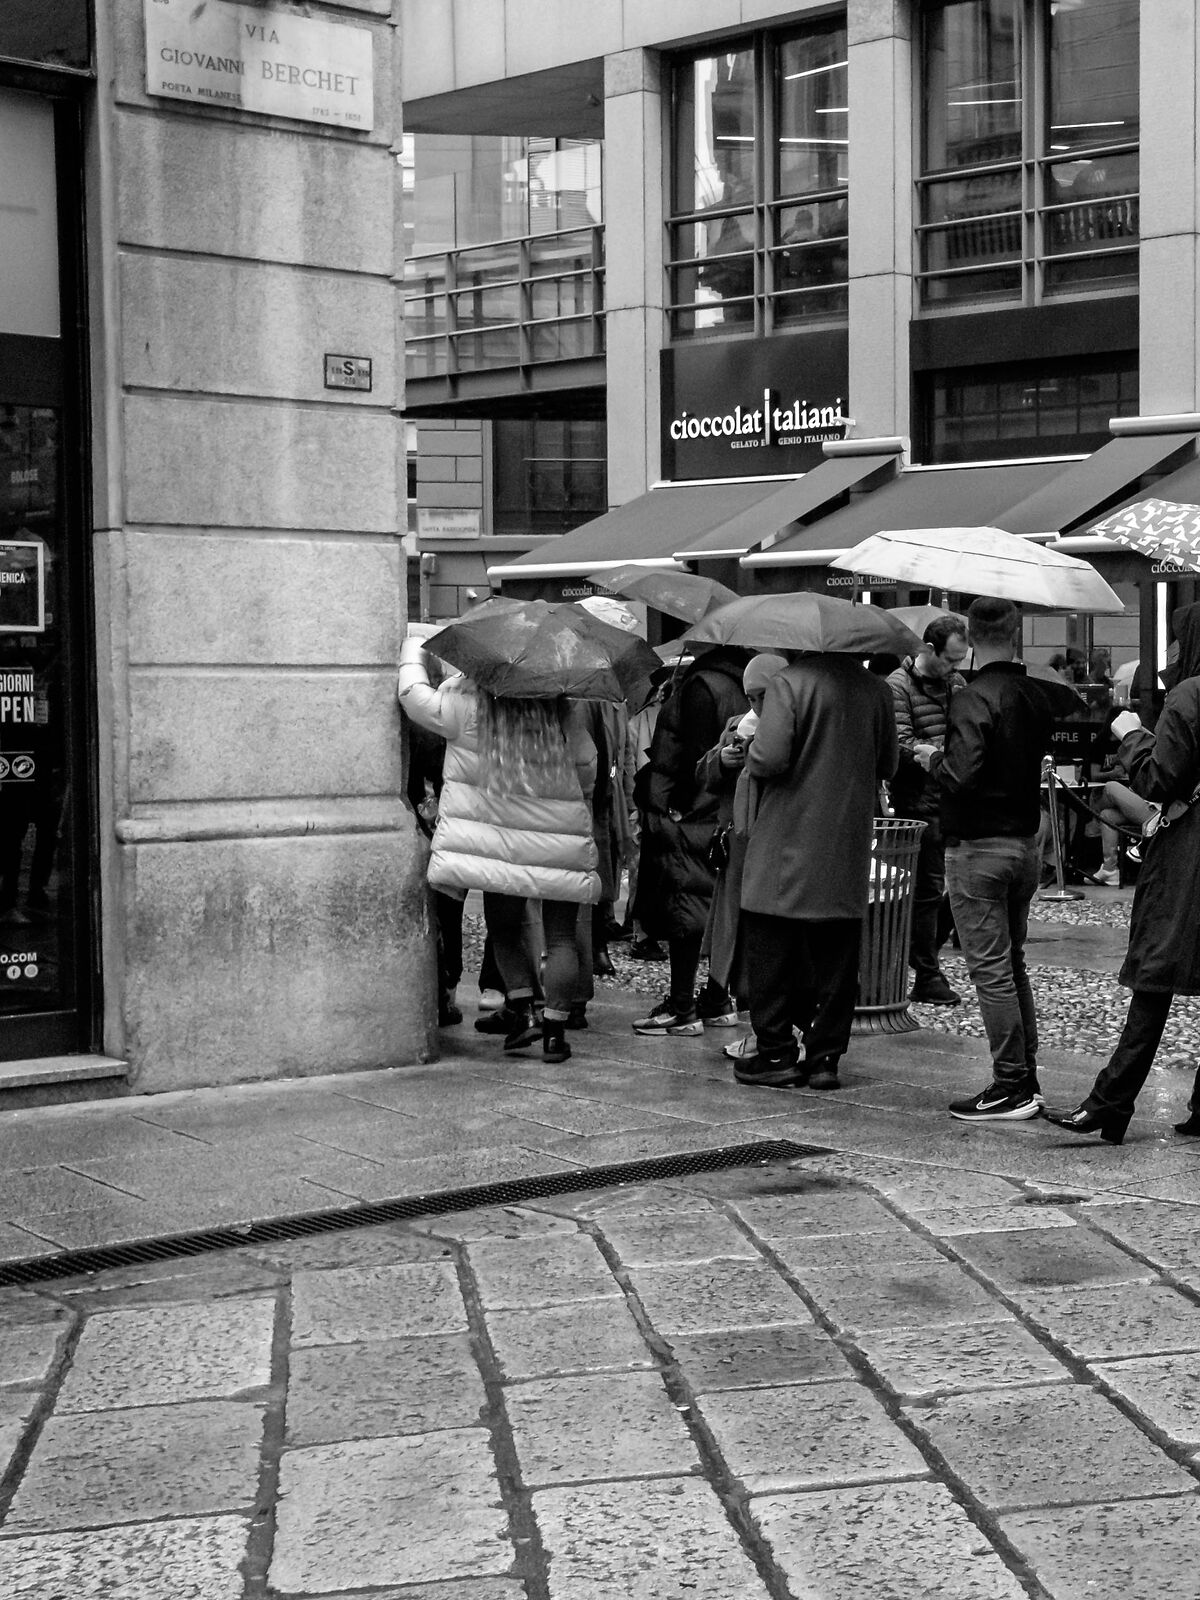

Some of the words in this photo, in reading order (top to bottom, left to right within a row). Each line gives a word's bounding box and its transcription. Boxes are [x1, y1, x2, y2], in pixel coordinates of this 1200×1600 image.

[245, 24, 280, 44] VIA
[160, 47, 245, 76] GIOVANNI
[261, 60, 359, 96] BERCHET
[162, 81, 192, 94] POETA
[731, 440, 759, 449] GELATO
[778, 437, 802, 446] GENIO
[804, 433, 840, 444] ITALIANO
[0, 571, 26, 584] ENICA
[1, 696, 34, 723] PEN
[1051, 731, 1079, 743] AFFLE
[0, 952, 37, 964] O.COM
